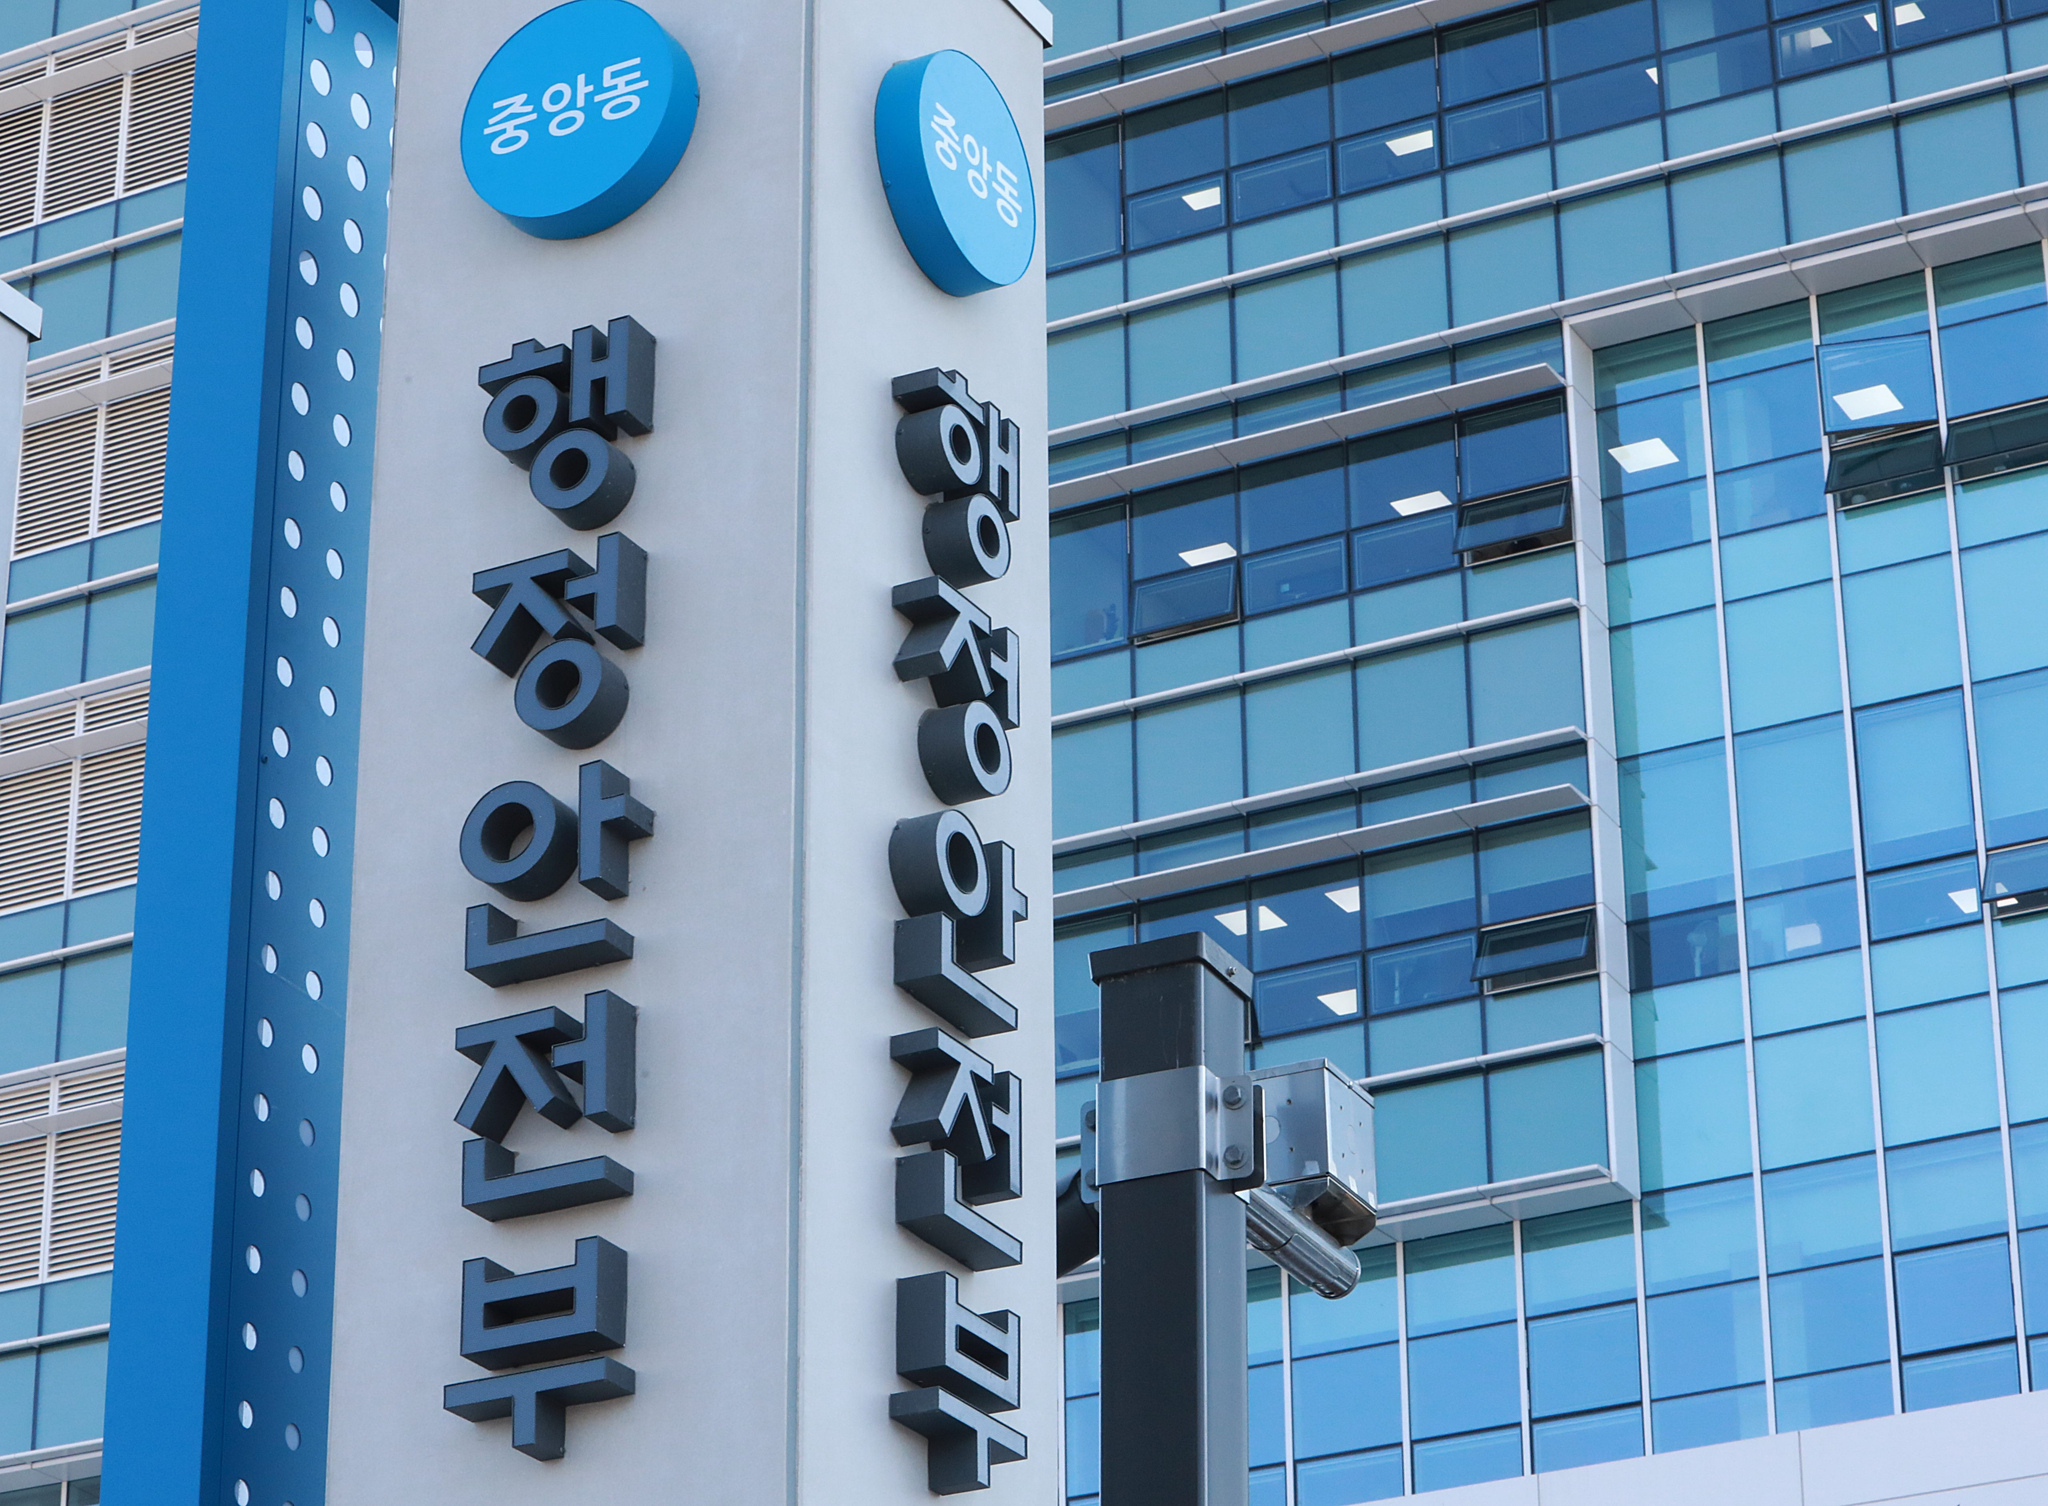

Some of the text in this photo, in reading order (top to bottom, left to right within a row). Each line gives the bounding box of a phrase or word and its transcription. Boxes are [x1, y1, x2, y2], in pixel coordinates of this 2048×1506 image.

[483, 57, 650, 155] 중앙동
[930, 102, 1024, 228] 중앙동
[443, 315, 656, 1461] 행정안전부
[889, 366, 1029, 1496] 행정안전부
